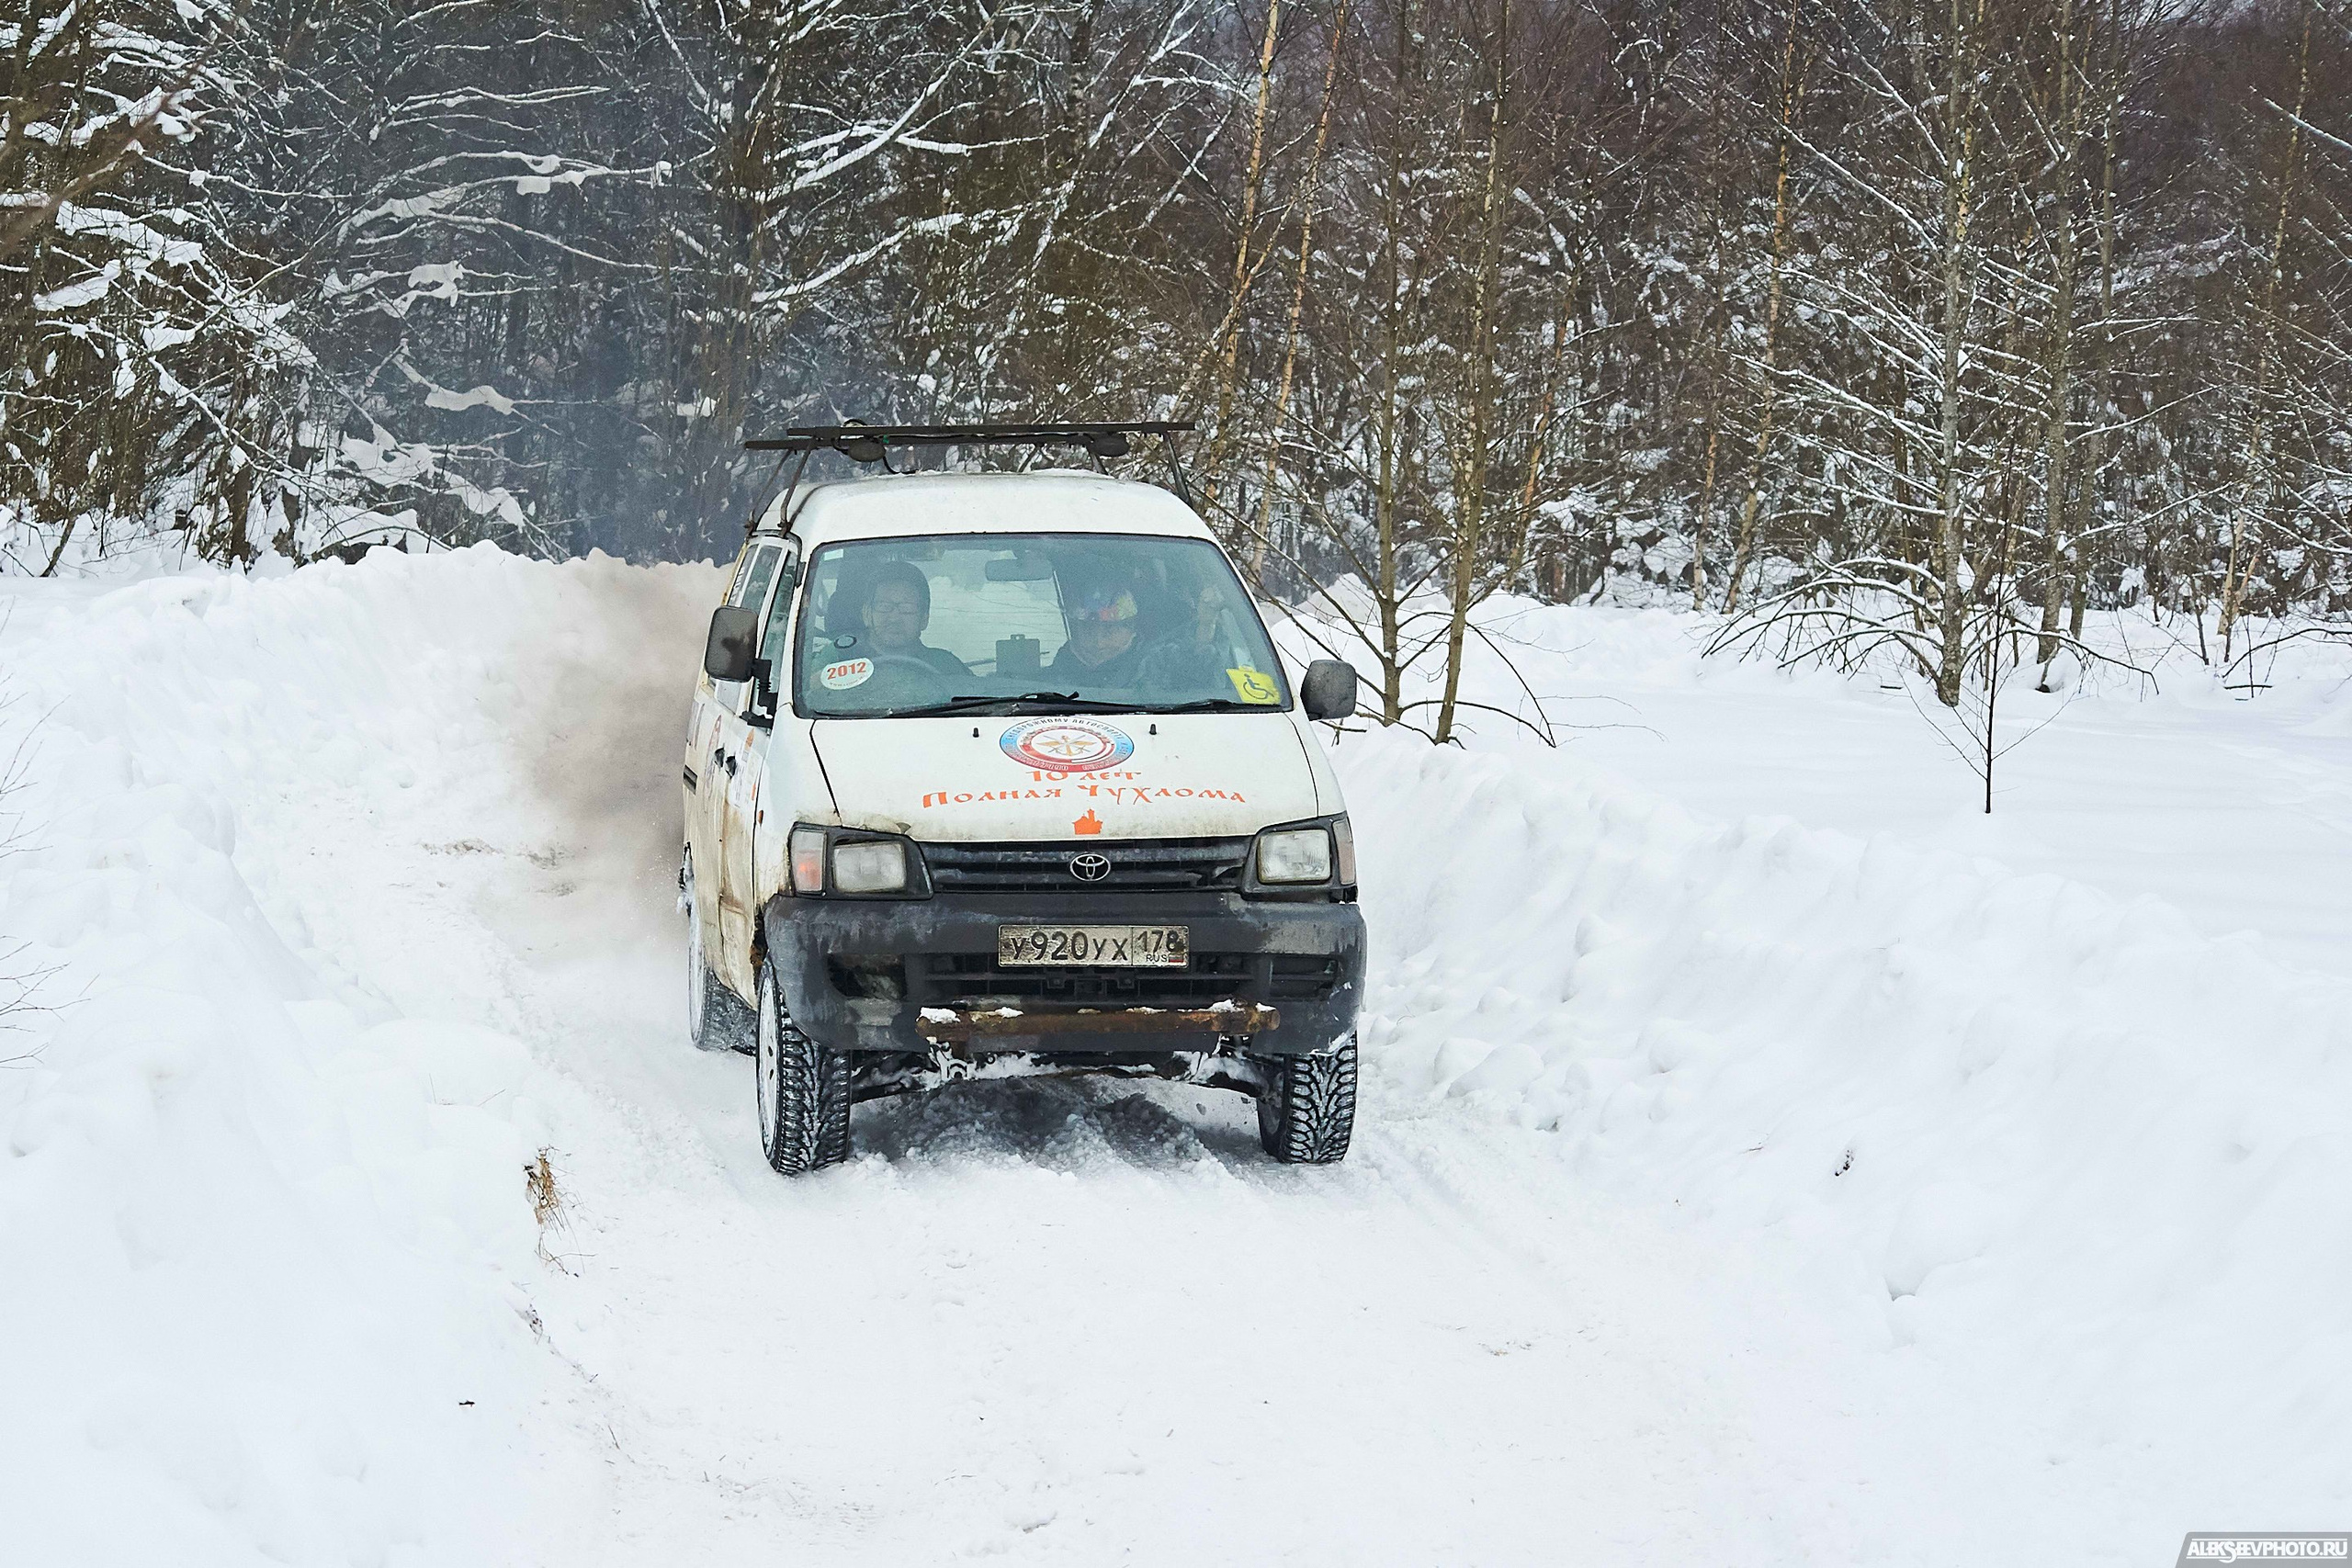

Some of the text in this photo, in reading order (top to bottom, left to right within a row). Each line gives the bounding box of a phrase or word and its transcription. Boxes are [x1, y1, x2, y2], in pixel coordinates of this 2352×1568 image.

[827, 661, 866, 681] 2012
[1025, 770, 1069, 782] 10
[1137, 930, 1180, 955] 178
[1146, 953, 1168, 963] RUS
